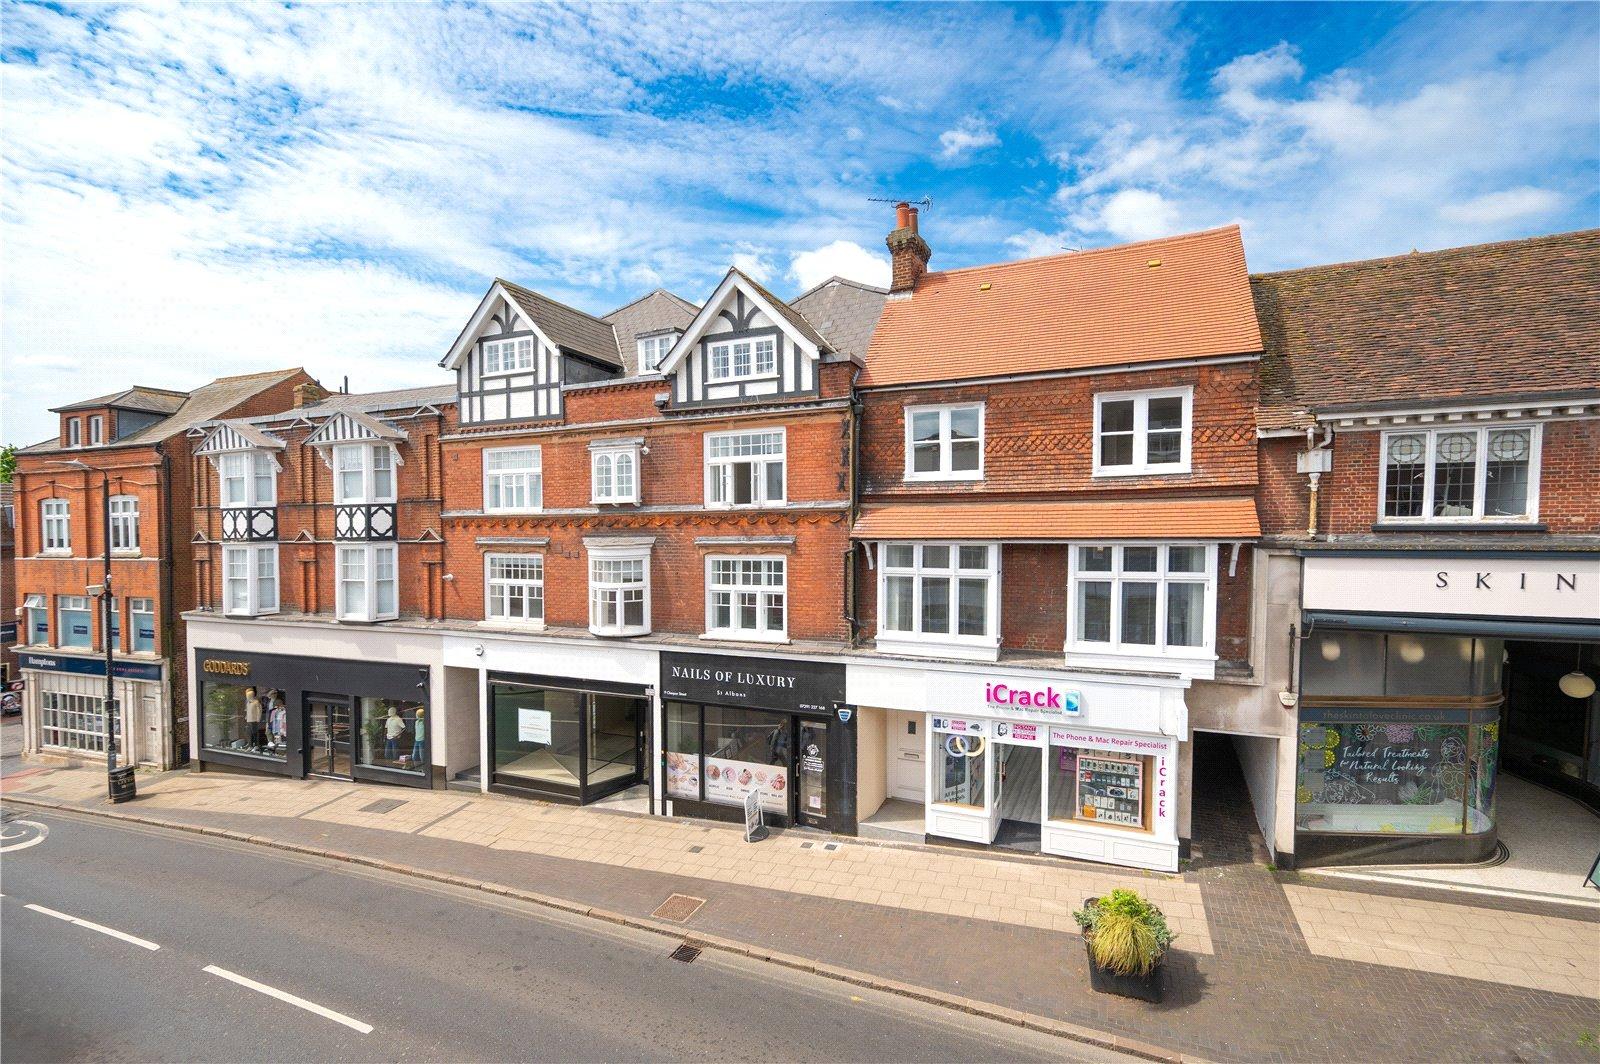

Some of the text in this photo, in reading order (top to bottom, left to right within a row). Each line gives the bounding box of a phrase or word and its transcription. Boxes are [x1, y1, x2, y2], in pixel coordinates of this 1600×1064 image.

[1435, 571, 1577, 590] SKIN
[28, 656, 56, 667] Hamptons
[672, 667, 796, 688] NAILS OF LUXURY
[986, 682, 1061, 709] iCrack
[1066, 734, 1087, 742] Phone
[1111, 738, 1133, 747] Repair
[1134, 741, 1168, 750] Specialist
[1343, 747, 1430, 759] Tailored Treatments
[1349, 760, 1387, 770] Natural
[1392, 760, 1427, 776] Looking
[1366, 773, 1400, 784] Results
